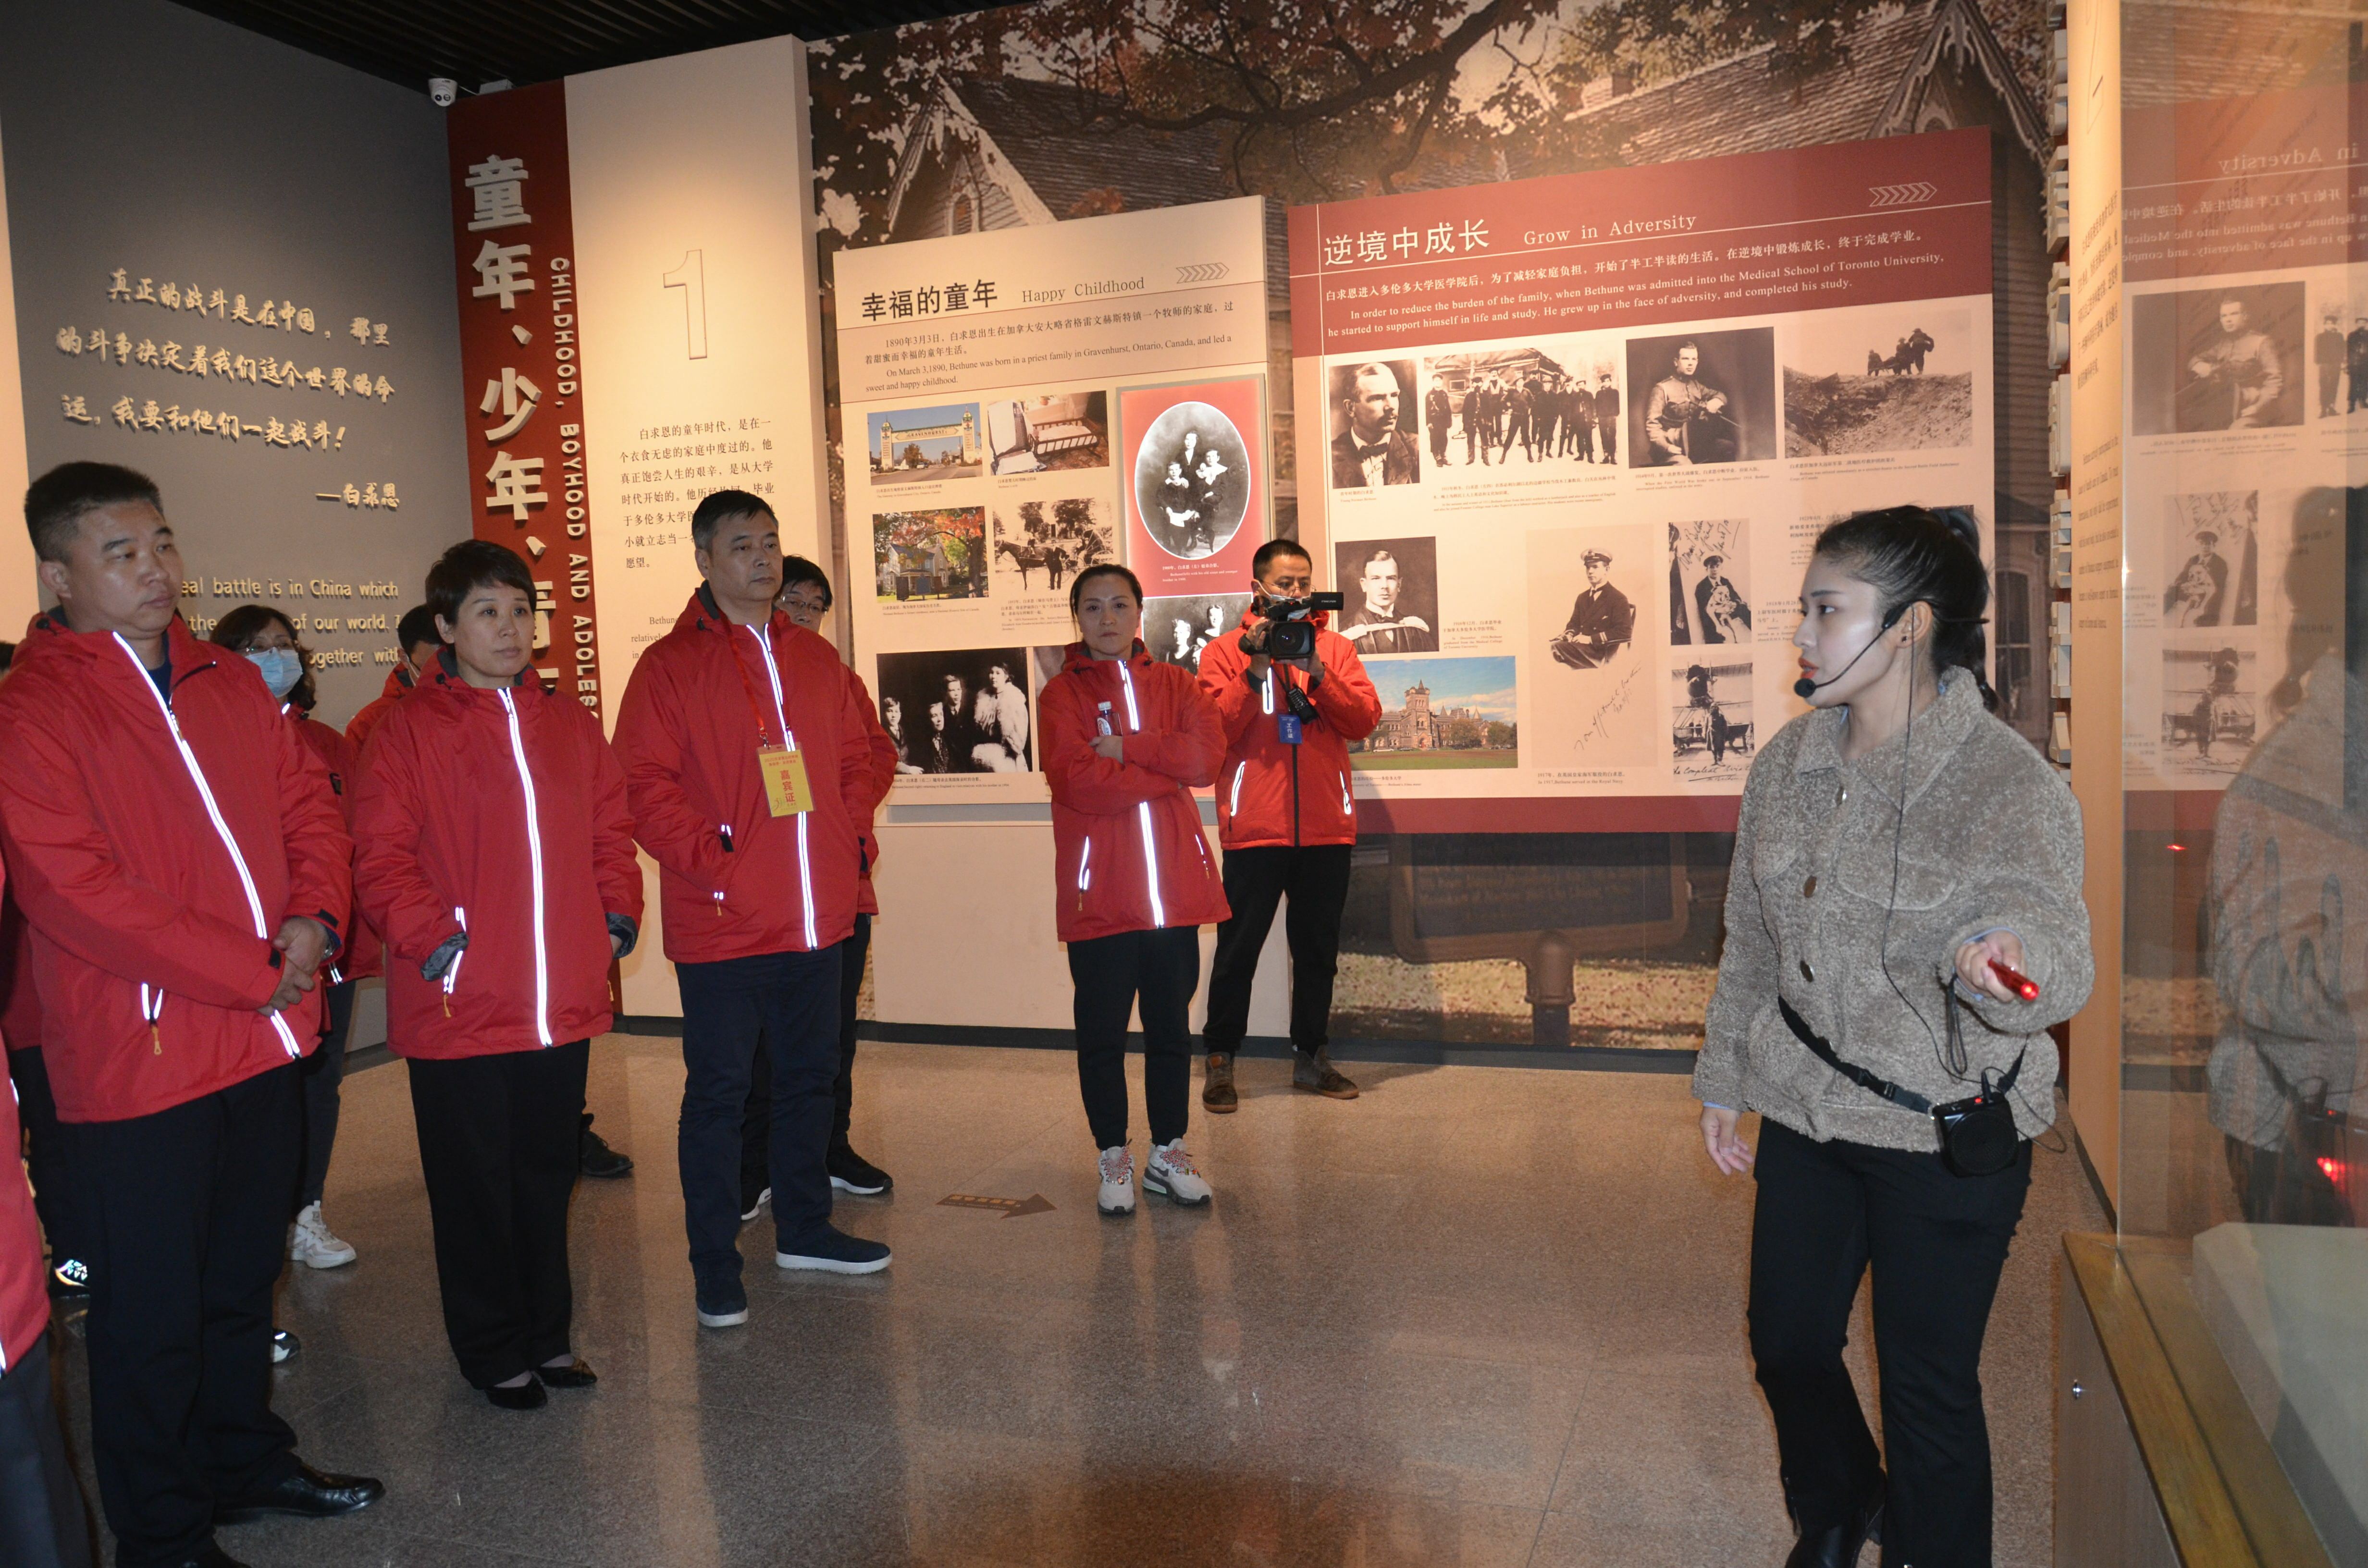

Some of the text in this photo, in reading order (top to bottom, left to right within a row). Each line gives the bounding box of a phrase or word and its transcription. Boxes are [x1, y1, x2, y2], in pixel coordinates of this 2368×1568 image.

[1324, 219, 1490, 266] 逆境中成长
[1524, 215, 1697, 245] Grow in Adversity
[662, 248, 708, 360] 1
[861, 279, 998, 322] 幸福的童年
[1022, 277, 1145, 303] Happy Childhood
[1328, 278, 1852, 337] he started to support himself in life and study. He grew up in the face of adversity, and completed his study.
[1351, 253, 1944, 319] In order to reduce the burden of the family, when Bethune was admitted into the Medical School of Toronto University,
[55, 326, 395, 404] 的斗争决定着我们这个世界的命
[899, 366, 920, 376] March
[950, 360, 977, 371] Bethune
[980, 360, 993, 368] was
[995, 357, 1011, 366] born
[1013, 356, 1020, 365] in
[1028, 354, 1048, 366] priest
[1049, 350, 1072, 361] family
[1075, 349, 1082, 357] in
[1084, 344, 1131, 357] Gravenhurst,
[1133, 341, 1163, 352] Ontario,
[1165, 338, 1196, 348] Canada,
[1197, 336, 1211, 345] and
[1213, 334, 1225, 343] led
[866, 376, 958, 392] sweet and happy childhood.
[465, 154, 560, 688] 童年、少年、
[560, 423, 586, 537] BOYHOOD
[568, 553, 591, 599] AND
[626, 557, 651, 569] 愿望。
[182, 577, 398, 597] eal battle is in China which
[314, 617, 339, 630] our
[572, 615, 599, 718] ADOLES
[779, 770, 796, 803] 嘉宾证
